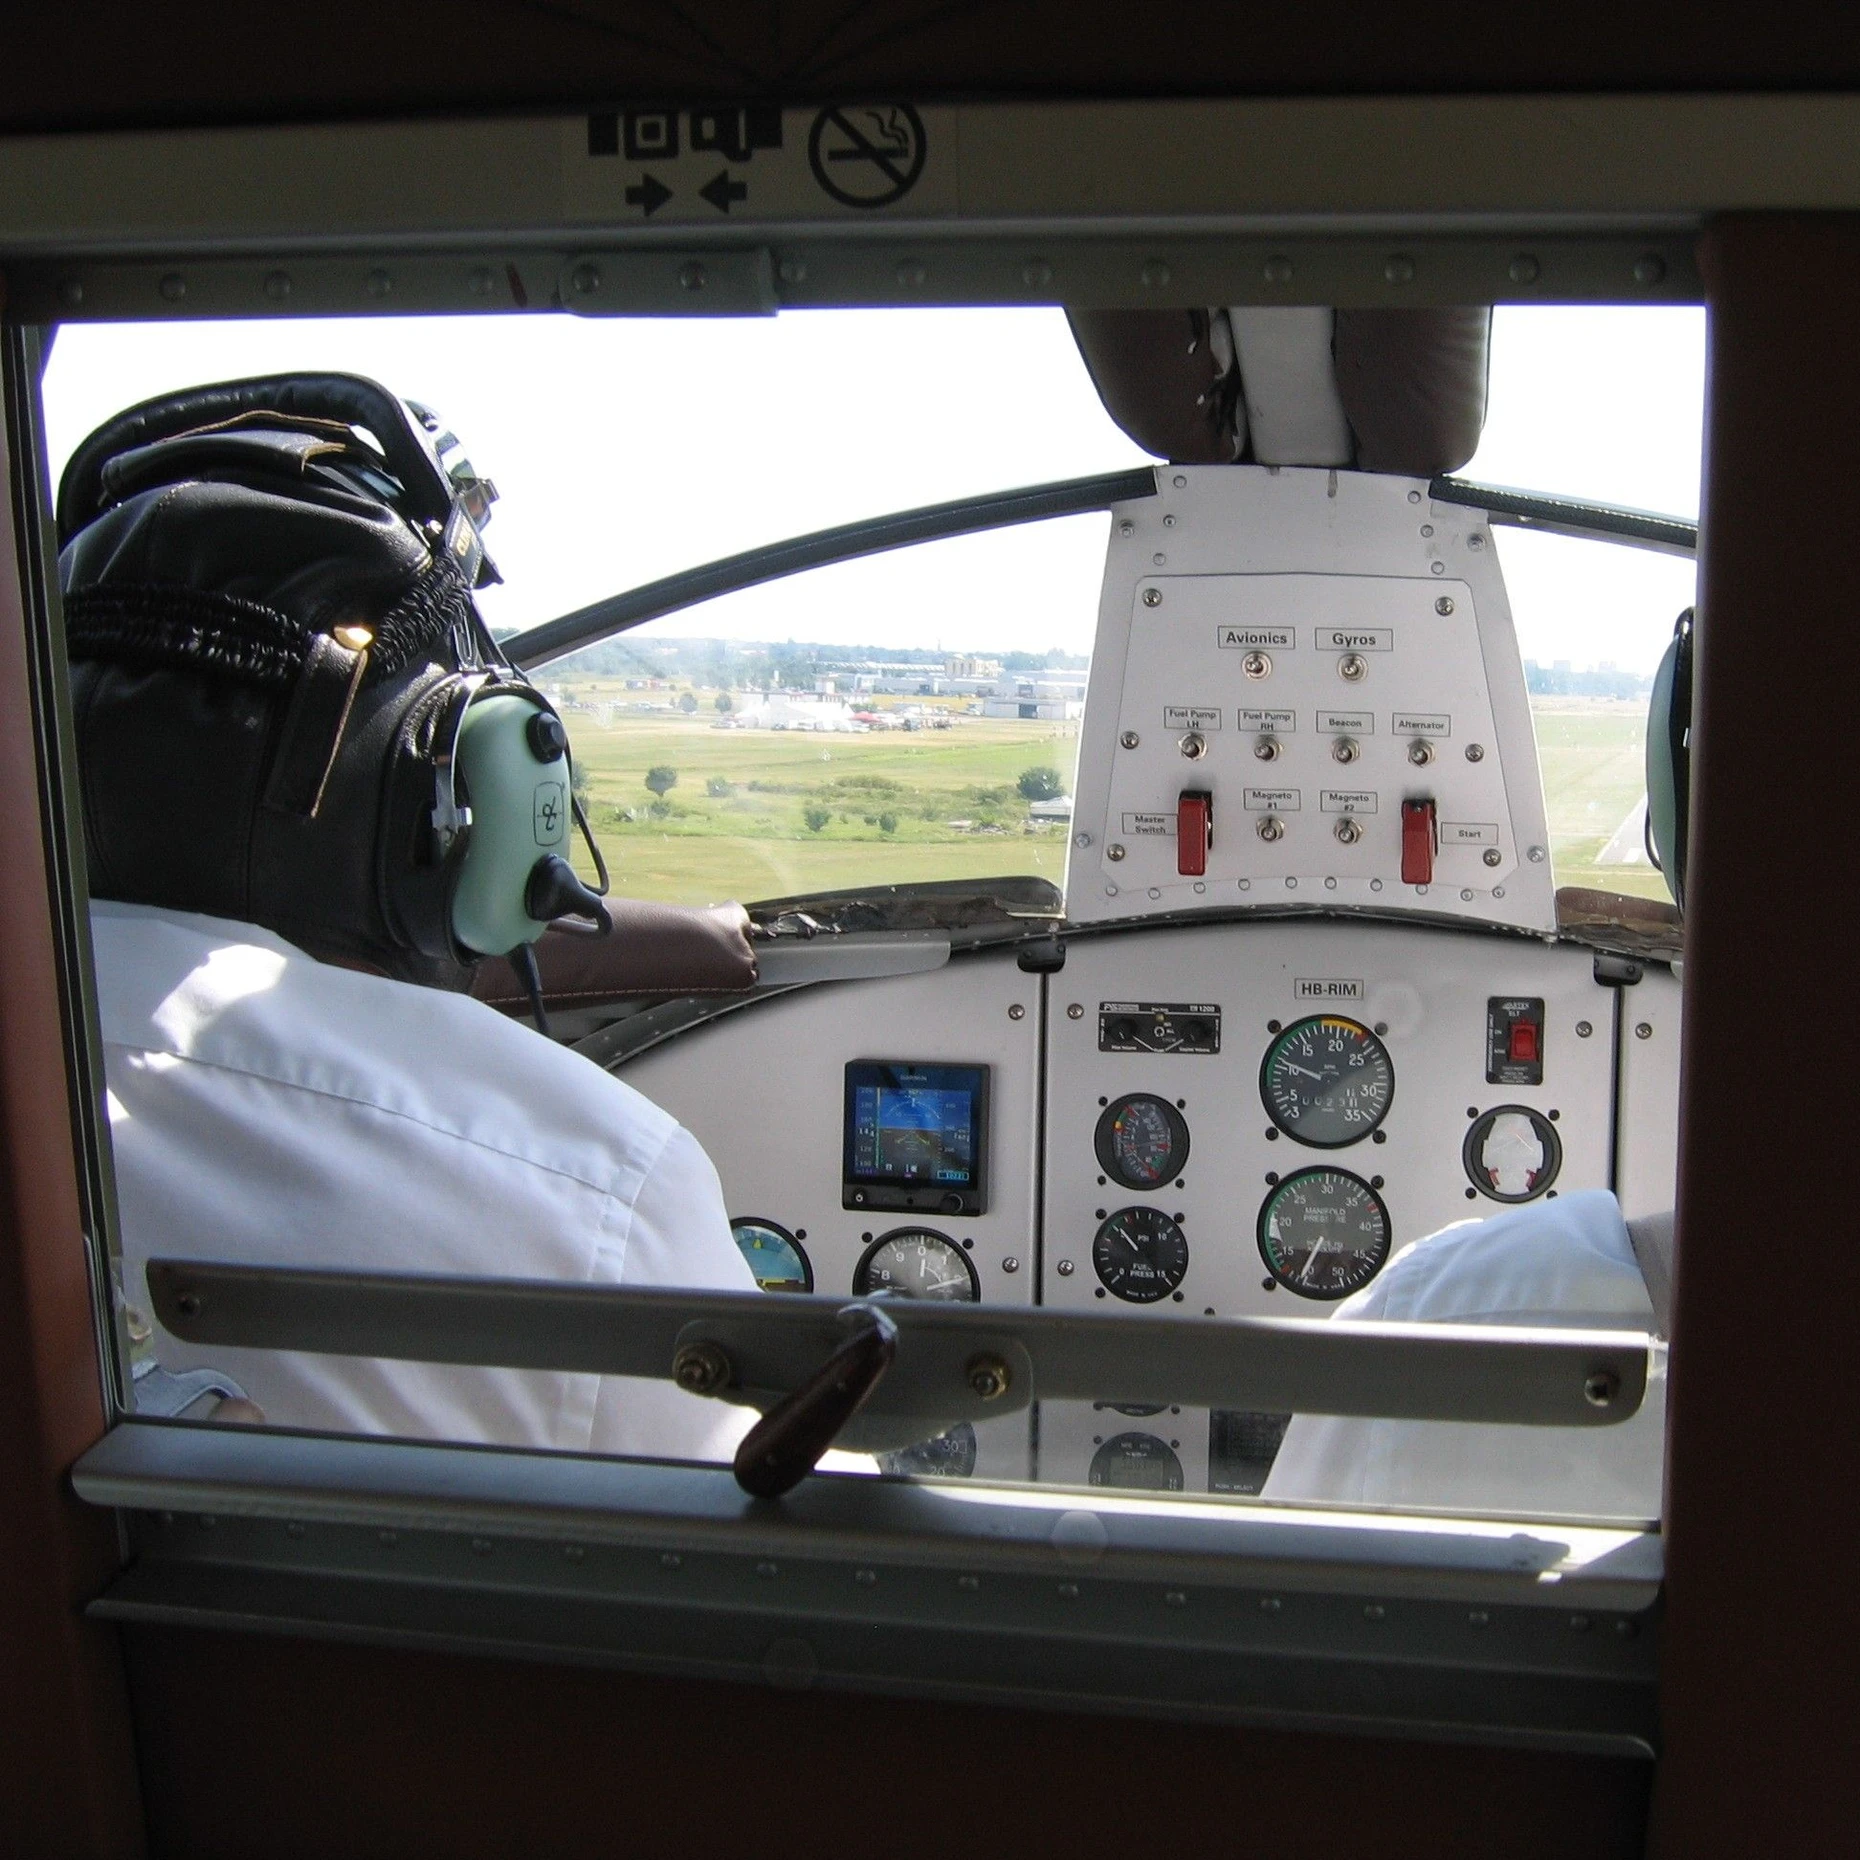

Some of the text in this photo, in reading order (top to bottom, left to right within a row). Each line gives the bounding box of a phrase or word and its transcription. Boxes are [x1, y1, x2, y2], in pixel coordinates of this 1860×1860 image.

[1226, 631, 1288, 645] Avionics
[1332, 632, 1376, 647] Gyros
[1169, 709, 1216, 720] Fuel Pump
[1243, 711, 1291, 722] Fuel Pump
[1186, 720, 1199, 728] LH
[1260, 722, 1274, 731] RH
[1328, 718, 1362, 727] Beacon
[1398, 720, 1444, 729] Alternator
[1252, 790, 1292, 800] Magneto
[1329, 792, 1369, 803] Magneto
[1134, 815, 1165, 824] Master
[1135, 825, 1166, 834] Switch
[1458, 829, 1482, 838] Start
[1301, 983, 1357, 996] HB-RIM
[1328, 1039, 1344, 1052] 20
[1302, 1045, 1313, 1057] 15
[1349, 1054, 1365, 1066] 25
[1290, 1089, 1298, 1101] 5
[1360, 1084, 1377, 1097] 30
[1292, 1107, 1300, 1119] 3
[1344, 1109, 1362, 1121] 35
[1321, 1185, 1333, 1194] 30
[1294, 1195, 1306, 1204] 25
[1346, 1197, 1358, 1207] 35
[1280, 1217, 1292, 1227] 20
[1359, 1221, 1371, 1231] 40
[917, 1245, 926, 1256] 0
[1282, 1246, 1294, 1255] 15
[1353, 1249, 1366, 1259] 45
[895, 1252, 904, 1262] 9
[881, 1269, 890, 1280] 8
[1130, 1270, 1155, 1279] PRESS
[1331, 1267, 1344, 1276] 50
